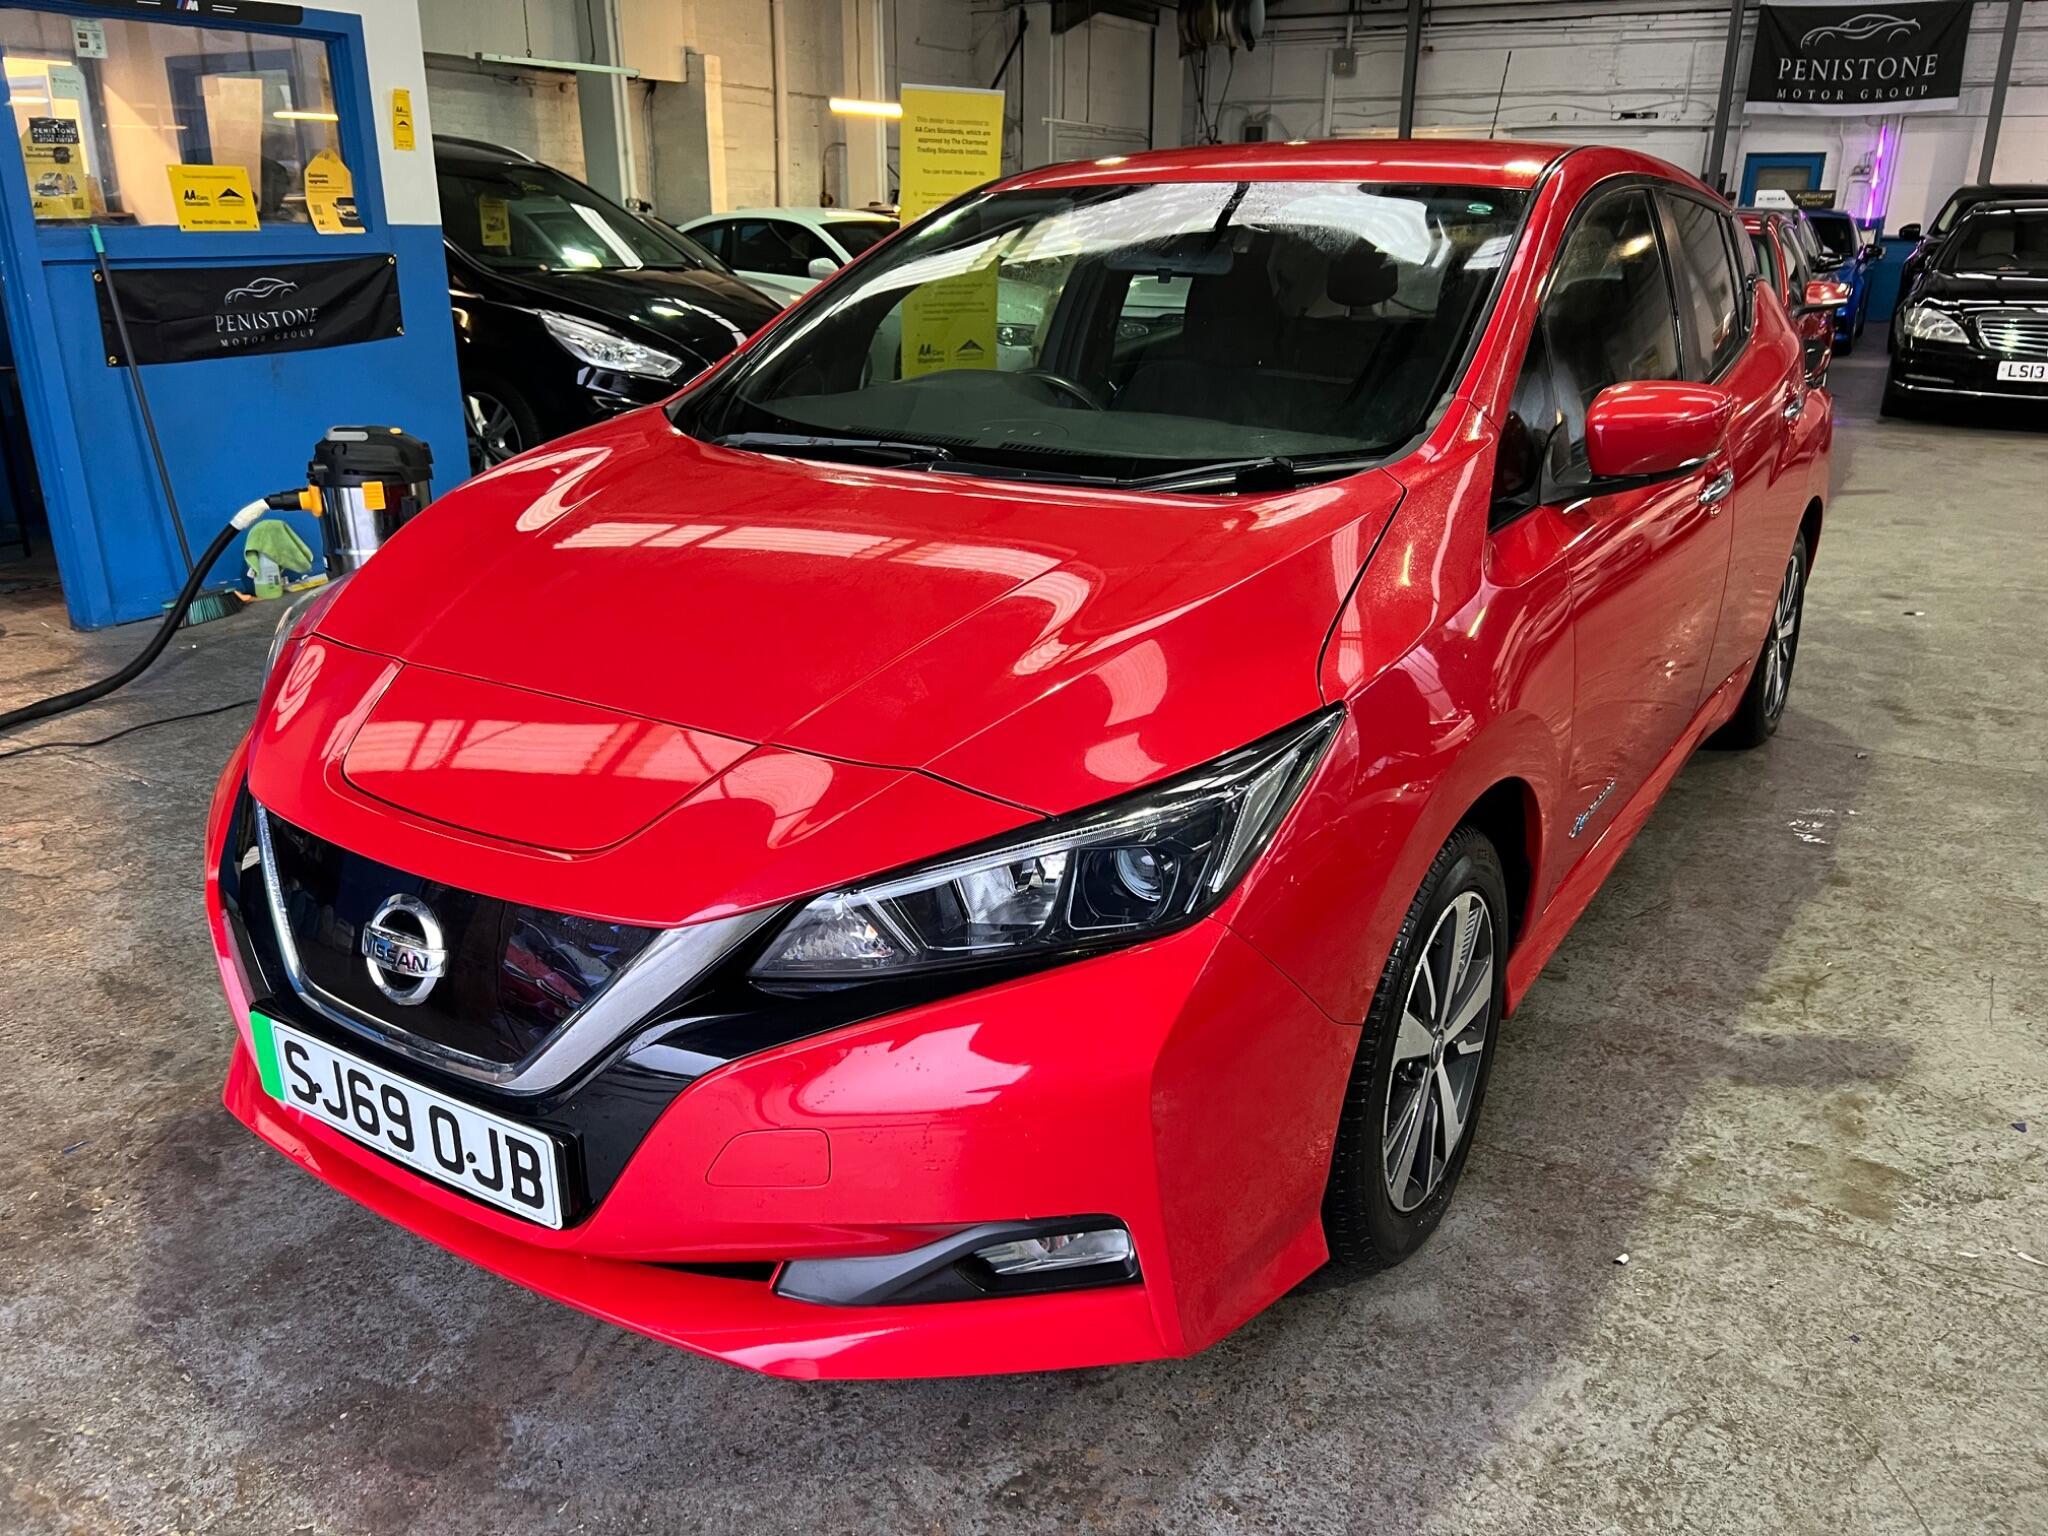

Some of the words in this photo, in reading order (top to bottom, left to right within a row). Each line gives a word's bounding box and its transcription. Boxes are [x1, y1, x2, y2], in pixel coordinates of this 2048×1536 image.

[1777, 53, 1939, 81] PENISTONE
[1776, 88, 1844, 100] MOTOR
[1859, 85, 1928, 99] GROUP
[33, 127, 77, 135] PENISTONE
[184, 189, 196, 200] AA
[214, 307, 319, 333] PENISTONE
[220, 334, 266, 347] MOTOR
[273, 328, 315, 341] GROUP
[2007, 364, 2045, 379] LS13
[365, 928, 429, 972] NISSAN
[284, 1039, 416, 1153] SJ69
[428, 1104, 545, 1210] OJB
